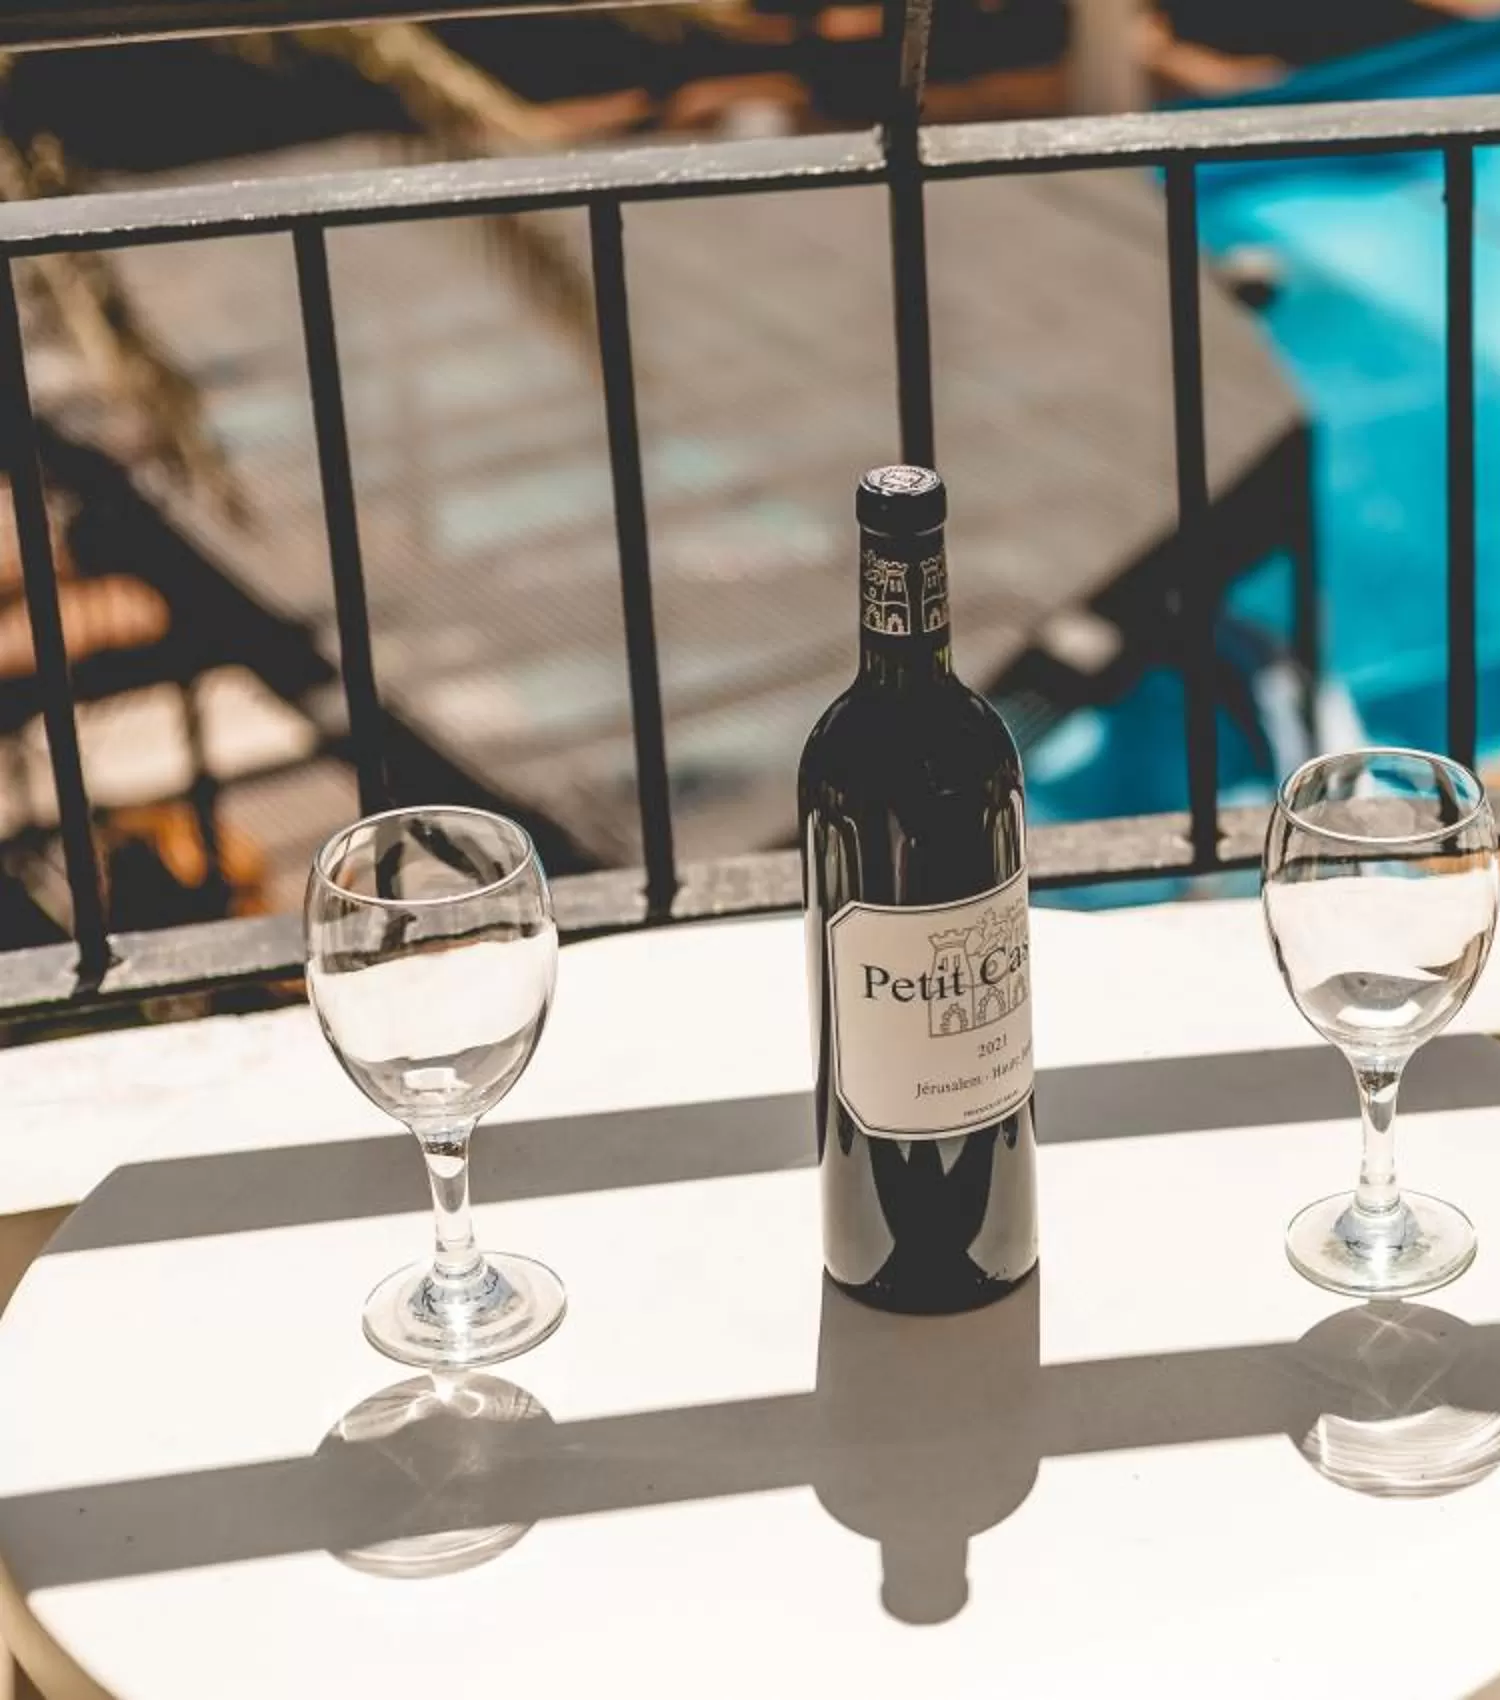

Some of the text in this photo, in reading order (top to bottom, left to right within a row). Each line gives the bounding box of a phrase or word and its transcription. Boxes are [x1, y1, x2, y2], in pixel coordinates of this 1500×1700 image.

[861, 963, 966, 1003] Petit
[978, 1032, 1007, 1058] 2021
[914, 1075, 981, 1100] Jérusalem
